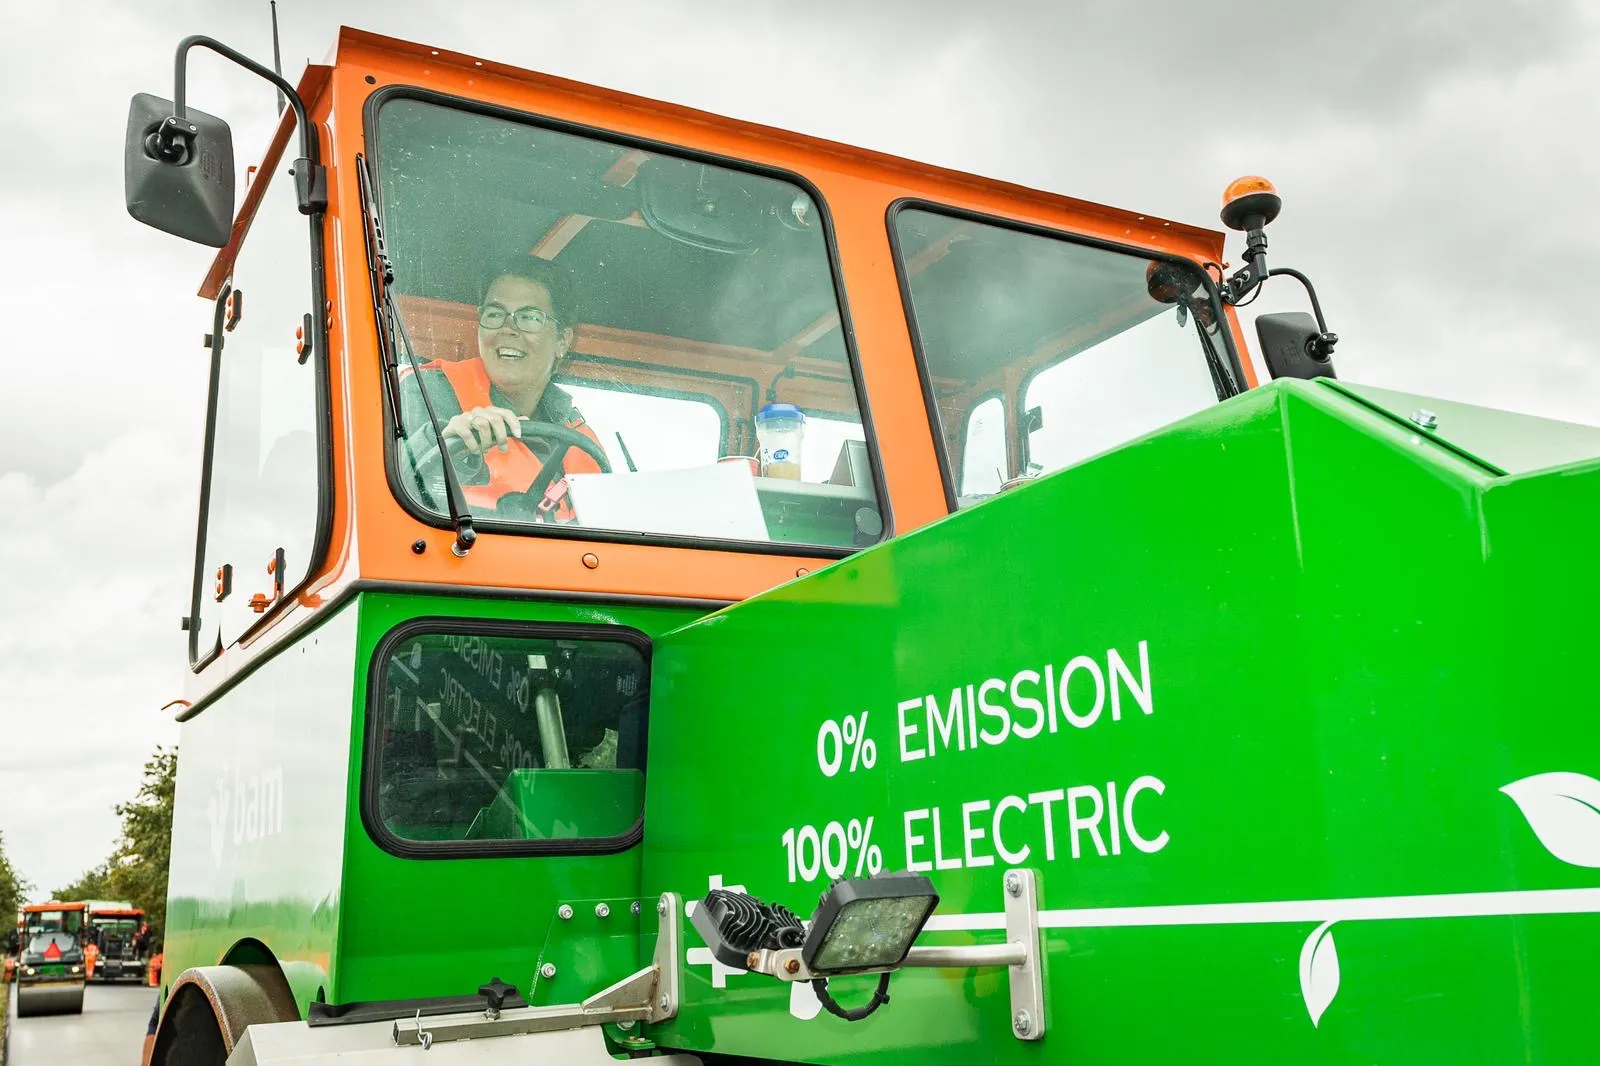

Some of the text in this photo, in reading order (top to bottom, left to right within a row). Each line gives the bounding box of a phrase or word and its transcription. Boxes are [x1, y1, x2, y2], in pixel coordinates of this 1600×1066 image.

[816, 640, 1154, 777] 0% EMISSION
[233, 756, 283, 846] bam
[782, 775, 1170, 884] 100% ELECTRIC
